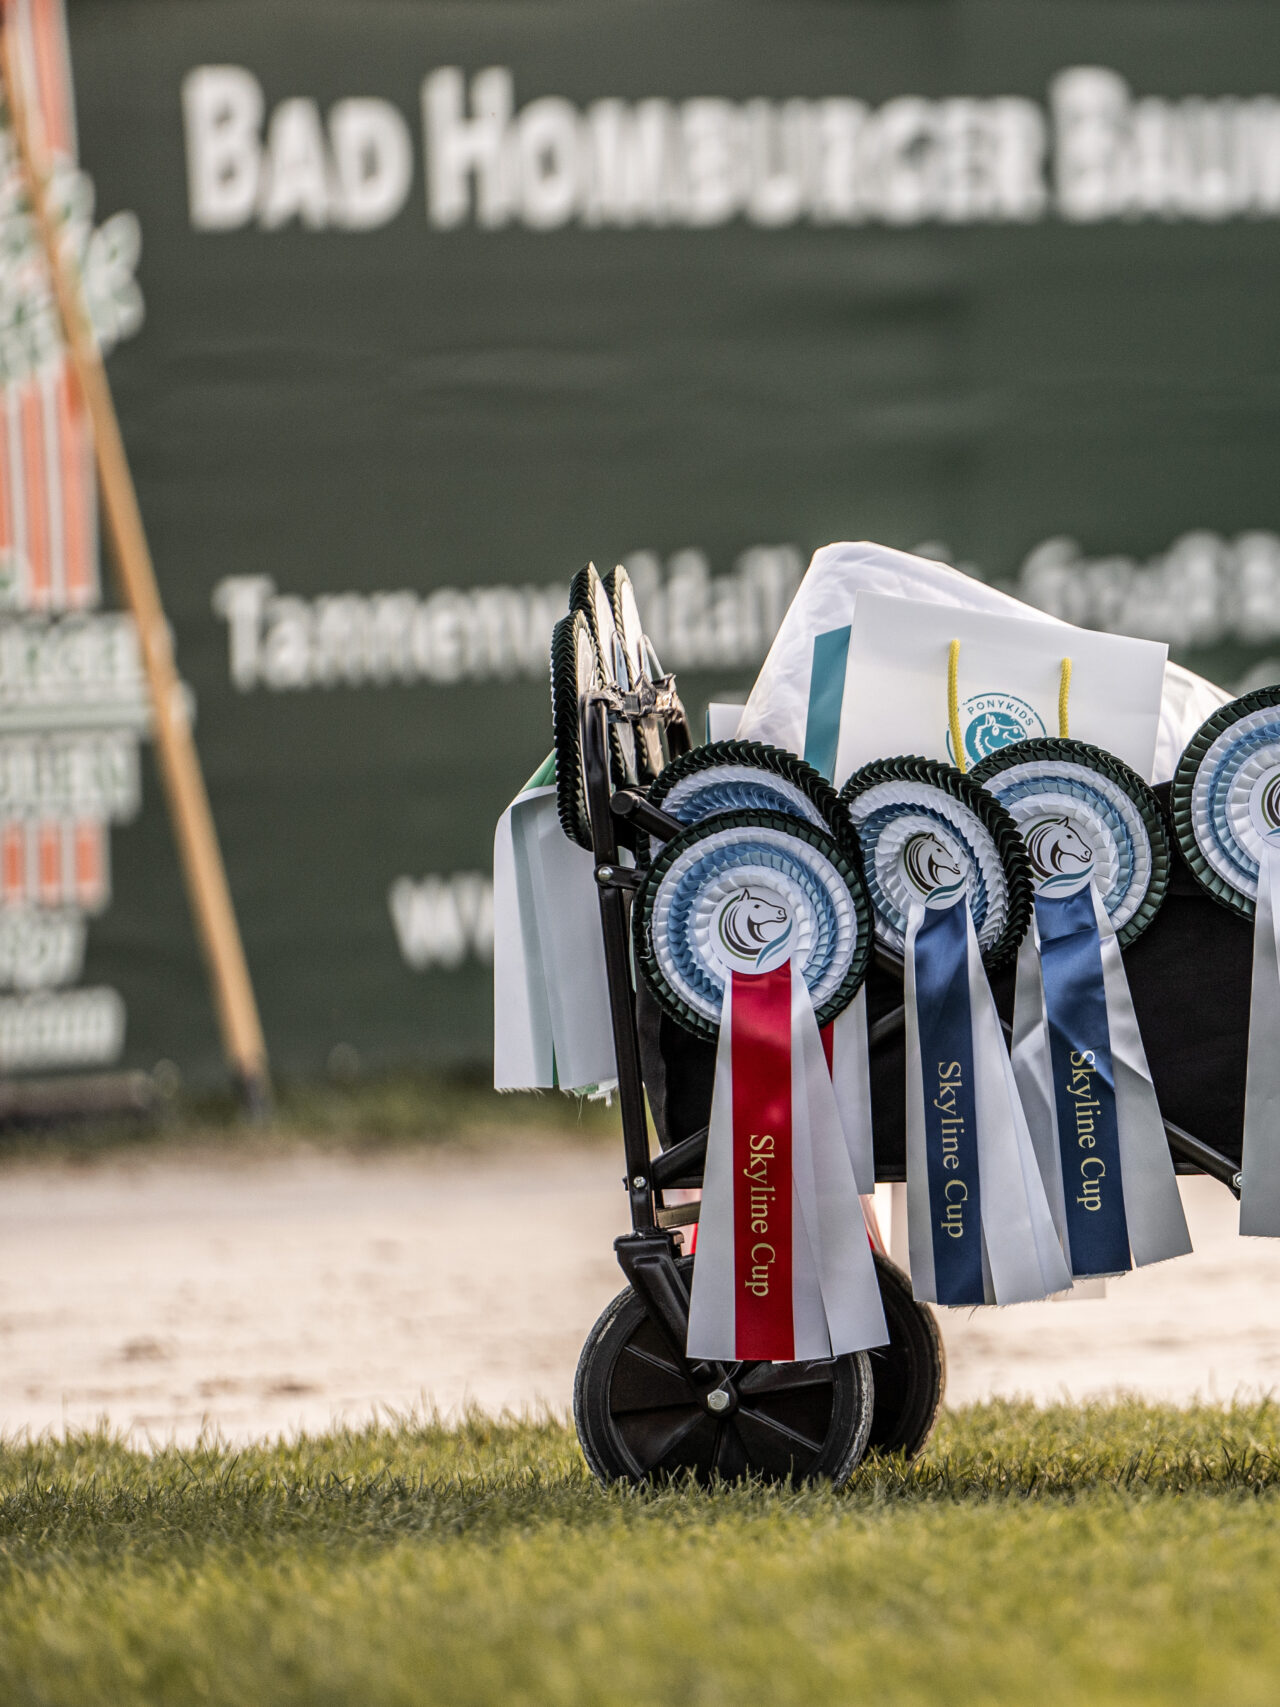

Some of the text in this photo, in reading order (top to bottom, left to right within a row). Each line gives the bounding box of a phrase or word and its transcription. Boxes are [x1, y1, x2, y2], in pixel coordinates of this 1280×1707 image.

[183, 64, 412, 232] BAD
[422, 64, 1046, 230] HOMBURGER
[967, 699, 1034, 726] PONYKIDS
[934, 1061, 968, 1238] Skyline Cup
[1067, 1049, 1106, 1211] Skyline Cup
[743, 1135, 775, 1297] Skyline Cup
